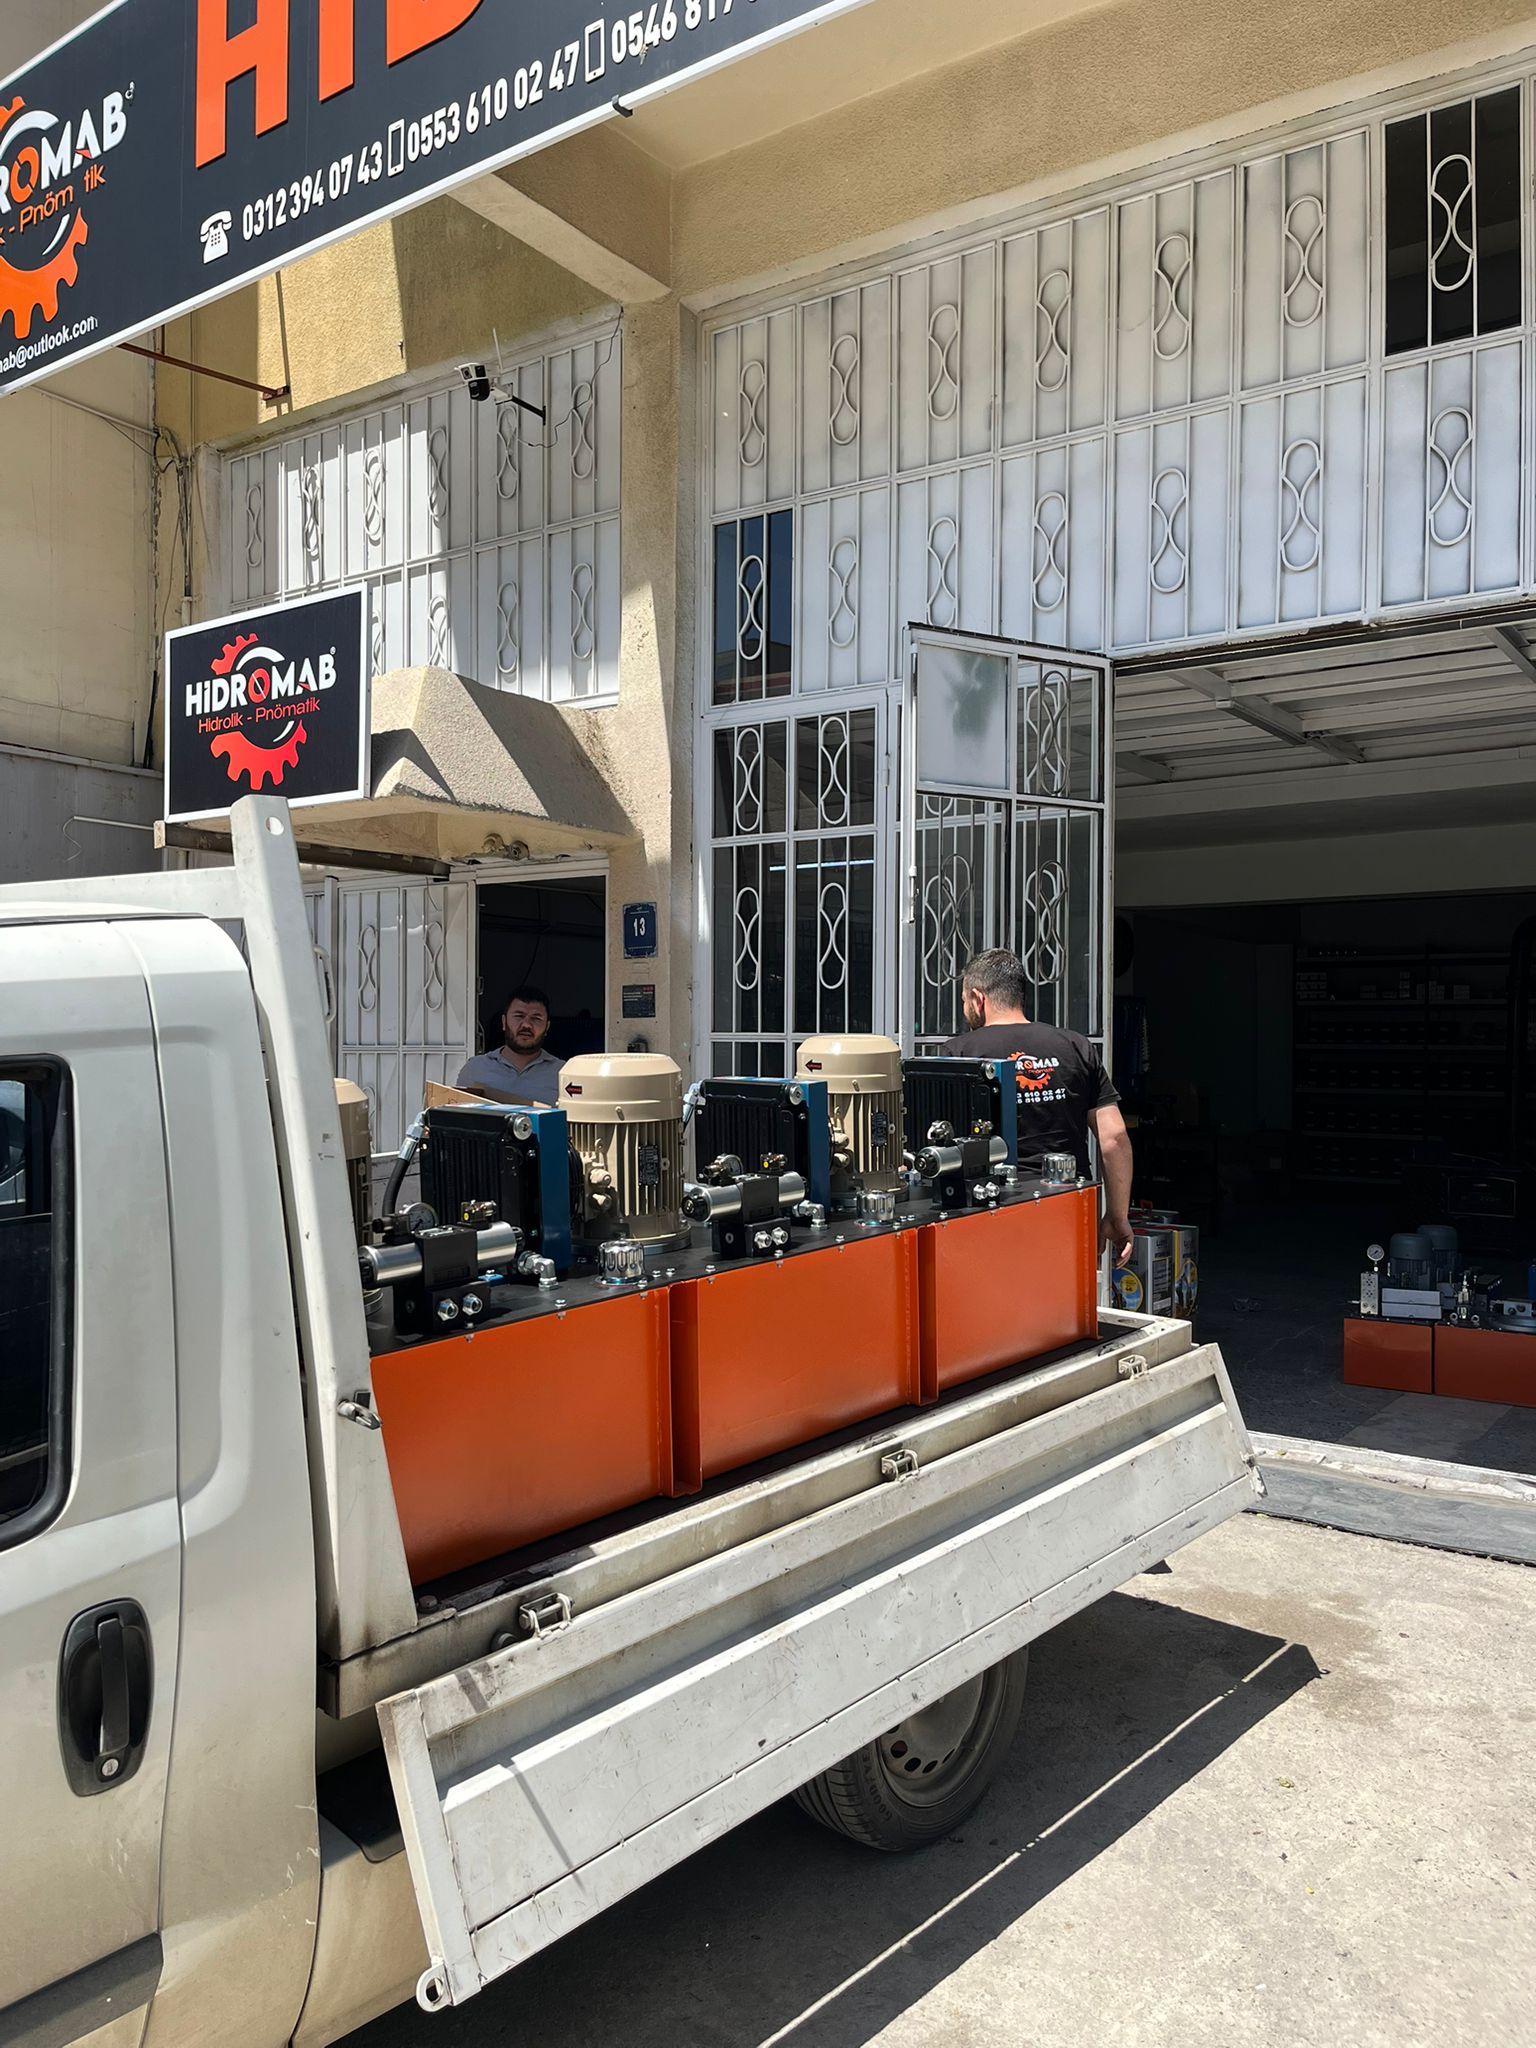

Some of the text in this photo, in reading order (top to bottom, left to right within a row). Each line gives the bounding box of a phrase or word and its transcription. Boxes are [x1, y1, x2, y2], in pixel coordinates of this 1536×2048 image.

[242, 187, 287, 241] 0312
[289, 168, 325, 220] 394
[329, 153, 353, 200] 07
[357, 140, 383, 185] 43
[407, 101, 461, 162] 0553
[465, 77, 508, 133] 610
[513, 59, 543, 110] 02
[548, 39, 580, 91] 47
[611, 0, 677, 64] 0546
[198, 712, 243, 735] Hidrolik
[255, 696, 321, 723] Pnömatik
[634, 917, 646, 936] 13
